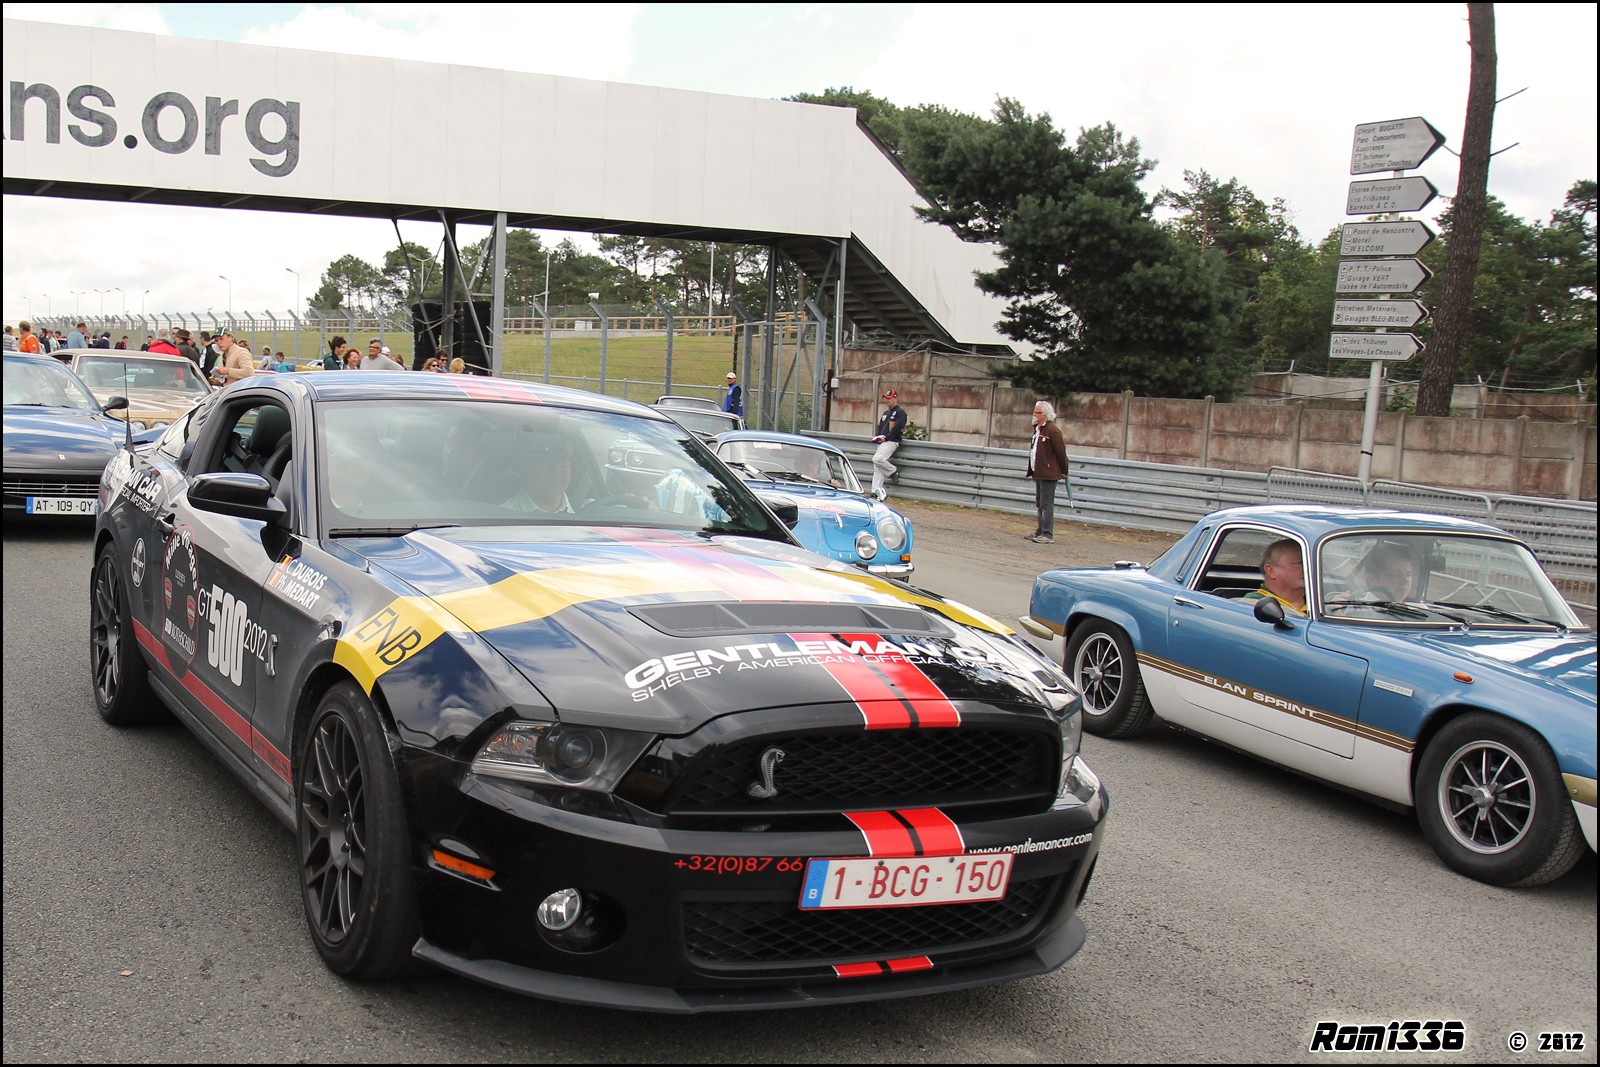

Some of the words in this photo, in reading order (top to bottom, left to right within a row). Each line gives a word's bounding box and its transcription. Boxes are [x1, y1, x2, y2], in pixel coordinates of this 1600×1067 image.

[3, 81, 300, 177] ns.org
[1379, 123, 1405, 133] BUGATTI
[1371, 184, 1402, 193] Principale
[1381, 227, 1415, 235] Rencontre
[1350, 244, 1385, 252] WELCOME
[1344, 315, 1369, 323] Garages
[1370, 315, 1409, 323] BLEU-BLANC
[1363, 338, 1388, 346] Tribunes
[1375, 348, 1402, 357] Chapelle
[138, 476, 162, 503] CAR
[165, 534, 181, 570] Mille
[181, 530, 198, 591] Virages
[244, 618, 268, 662] 2012
[354, 606, 422, 667] ENB
[624, 640, 944, 690] GENTLEMAN
[631, 664, 725, 703] SHELBY
[737, 654, 857, 672] AMERICAN
[863, 654, 953, 667] OFFICIAL
[1203, 675, 1247, 697] ELAN
[1252, 691, 1317, 719] SPRINT
[674, 855, 774, 875] +32(0)87
[808, 888, 819, 899] B
